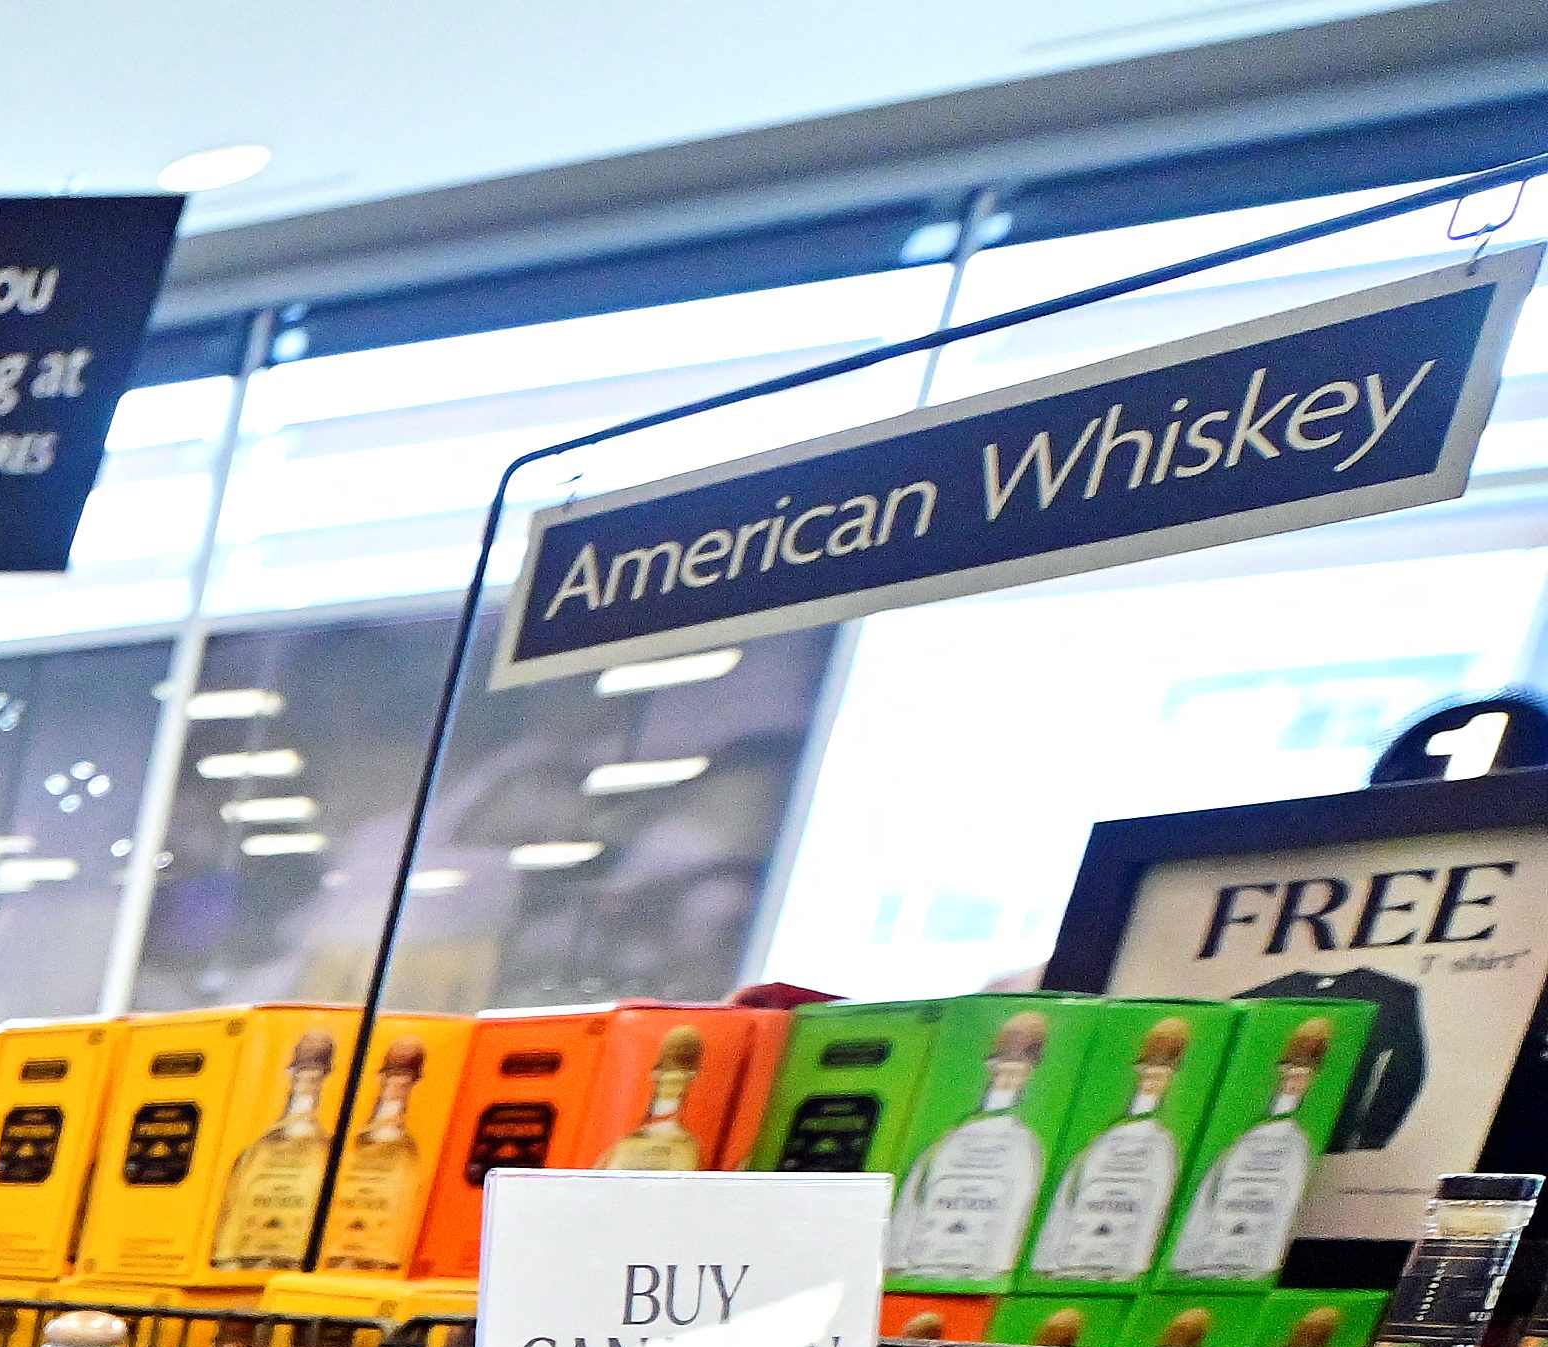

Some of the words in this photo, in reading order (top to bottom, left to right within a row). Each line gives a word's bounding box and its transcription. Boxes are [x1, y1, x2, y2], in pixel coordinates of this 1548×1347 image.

[31, 347, 92, 399] at
[544, 475, 938, 621] American
[981, 358, 1436, 525] Whiskey
[1197, 859, 1519, 962] FREE
[622, 1264, 750, 1326] BUY
